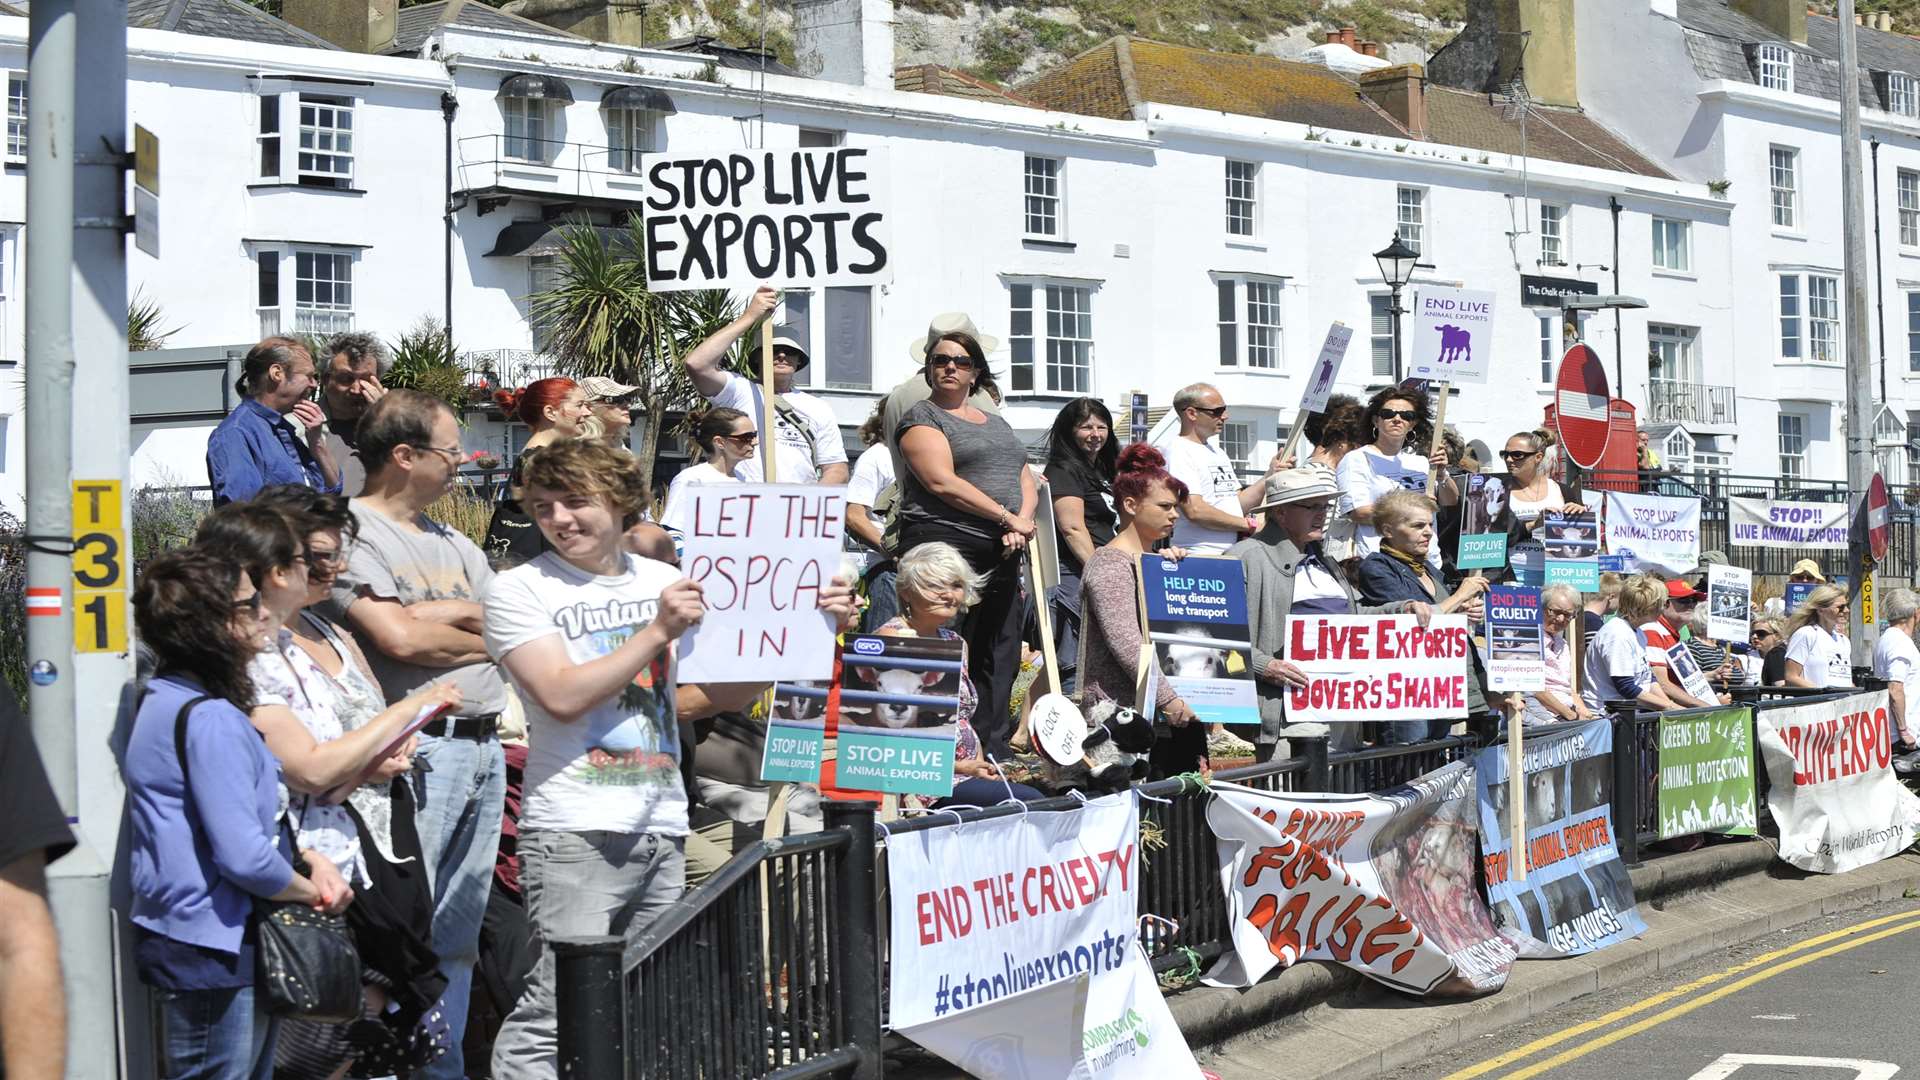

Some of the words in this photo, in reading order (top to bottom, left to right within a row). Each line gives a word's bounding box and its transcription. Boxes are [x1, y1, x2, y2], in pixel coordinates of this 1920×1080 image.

[646, 154, 755, 211] STOP
[764, 149, 871, 205] LIVE
[646, 212, 887, 281] EXPORTS
[1528, 285, 1540, 294] The
[1541, 287, 1558, 296] Chalk
[1425, 298, 1456, 311] END
[1460, 301, 1489, 313] LIVE
[1424, 311, 1453, 319] ANIMAL
[1455, 313, 1488, 322] EXPORTS
[694, 495, 760, 538] LET
[779, 495, 840, 538] THE
[1633, 508, 1655, 520] STOP
[1657, 510, 1678, 522] LIVE
[1770, 507, 1822, 524] STOP!!
[1614, 525, 1650, 540] ANIMAL
[1652, 528, 1695, 542] EXPORTS
[1735, 524, 1758, 540] LIVE
[1762, 525, 1805, 542] ANIMAL
[1806, 528, 1848, 543] EXPORT
[1464, 541, 1486, 552] STOP
[1486, 540, 1503, 550] LIVE
[689, 554, 821, 611] RSPCA
[1552, 568, 1574, 576] STOP
[1576, 568, 1594, 577] LIVE
[1164, 577, 1195, 592] HELP
[1199, 578, 1226, 592] END
[1165, 591, 1188, 604] long
[1188, 592, 1226, 605] distance
[1491, 594, 1514, 606] END
[1516, 595, 1537, 606] THE
[554, 598, 659, 640] Vintag
[1167, 604, 1184, 616] live
[1185, 606, 1229, 620] transport
[1491, 607, 1538, 620] CRUELTY
[738, 627, 787, 657] IN
[1376, 619, 1468, 659] EXPORTS
[1291, 674, 1383, 710] DOVER'S
[1386, 672, 1465, 709] SHAME
[1663, 723, 1692, 749] GREENS
[1696, 721, 1711, 745] FOR
[771, 738, 799, 754] STOP
[798, 740, 818, 756] LIVE
[847, 745, 895, 763] STOP
[900, 750, 943, 767] LIVE
[1541, 742, 1553, 768] no
[1804, 720, 1838, 785] LIVE
[790, 760, 816, 770] EXPORTS
[846, 766, 887, 778] ANIMAL
[890, 769, 942, 782] EXPORTS
[1662, 764, 1693, 790] ANIMAL
[1531, 831, 1566, 870] ANIMAL
[1842, 829, 1865, 853] World
[917, 885, 973, 946] END
[974, 872, 1018, 930] THE
[1022, 844, 1134, 918] CRUELTY
[1549, 922, 1577, 952] use
[1573, 897, 1623, 946] yours!
